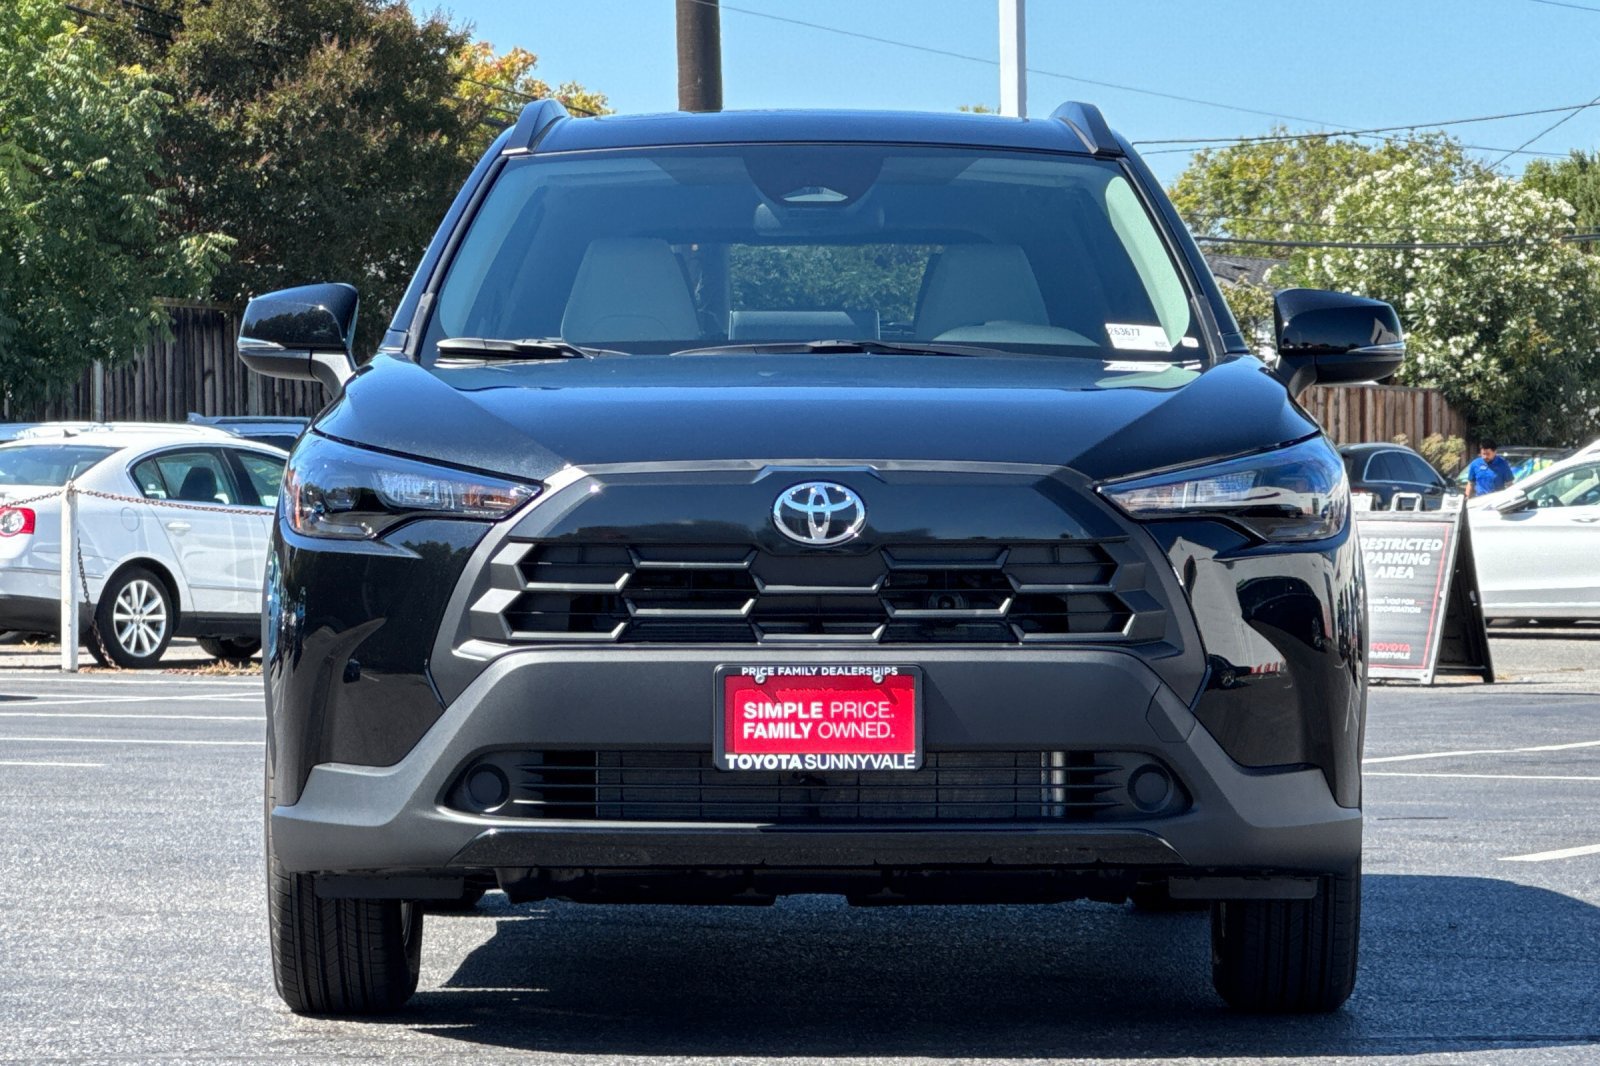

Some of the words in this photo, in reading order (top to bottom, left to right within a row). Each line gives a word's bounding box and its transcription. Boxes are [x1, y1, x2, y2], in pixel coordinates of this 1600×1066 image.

[1108, 327, 1140, 337] 263677
[1360, 538, 1442, 551] RESTRICTED
[1365, 551, 1431, 565] PARKING
[1375, 566, 1414, 578] AREA
[1371, 642, 1411, 652] TOYOTA
[741, 666, 775, 677] PRICE
[777, 666, 818, 676] FAMILY
[821, 666, 899, 676] DEALERSHIPS
[743, 701, 824, 719] SIMPLE
[830, 701, 895, 719] PRICE.
[743, 722, 813, 739] FAMILY
[817, 722, 896, 739] OWNED.
[725, 754, 804, 770] TOYOTA
[804, 754, 916, 770] SUNNYVALE
